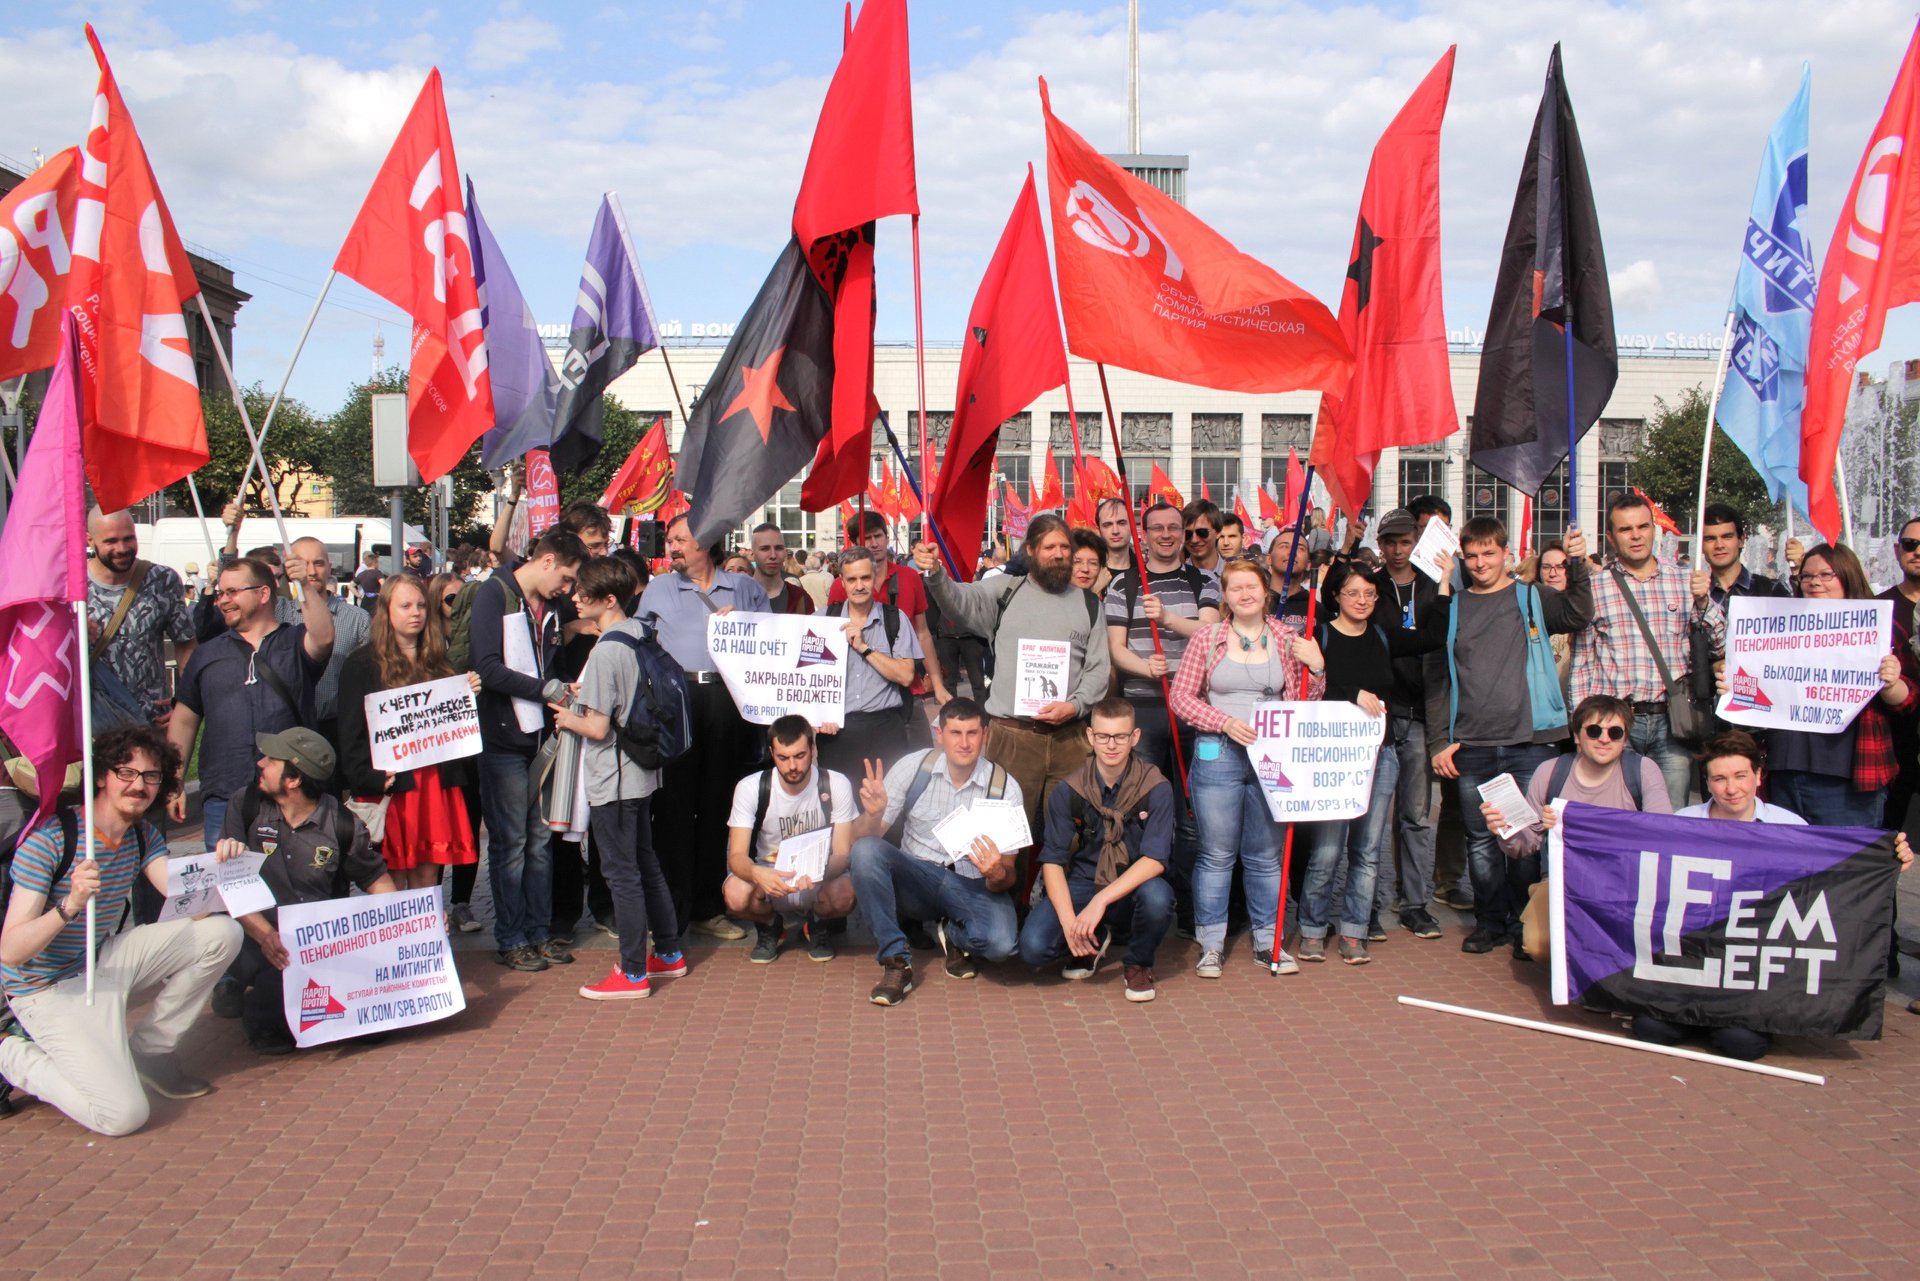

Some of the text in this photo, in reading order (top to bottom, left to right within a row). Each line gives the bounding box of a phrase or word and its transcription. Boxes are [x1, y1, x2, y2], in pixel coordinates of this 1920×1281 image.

[1153, 303, 1207, 329] ПАРТИЯ
[713, 621, 758, 637] ХВАТИТ
[1736, 608, 1877, 635] ПРОТИВ ПОВЫШЕНИЯ
[713, 638, 788, 656] ЗА НАШ СЧЁТ
[801, 643, 825, 654] ПРОТИВ
[802, 635, 825, 649] НАРОД
[1734, 630, 1878, 652] ПЕНСИОННОГО ВОЗРАСТА?
[1025, 661, 1059, 669] СРАЖАЙСЯ
[744, 671, 842, 688] ЗАКРЫВАТЬ ДЫРЫ
[1733, 674, 1758, 688] НАРОД
[1763, 664, 1882, 687] ВЫХОДИ НА МИТИНГ
[776, 688, 842, 704] В БЮДЖЕТЕ!
[1733, 683, 1758, 696] ПРОТИВ
[1805, 686, 1817, 699] 16
[379, 702, 387, 714] К
[400, 695, 473, 724] ПОЛИТИЧЕСКОЕ
[1254, 709, 1381, 738] НЕТ ПОВЫШЕНИЮ
[392, 722, 481, 761] СОПРОТИВЛЕНИЕ
[1259, 761, 1281, 772] НАРОД
[296, 894, 435, 947] ПРОТИВ ПОВЫШЕНИЯ
[300, 914, 437, 965] ПЕНСИОННОГО ВОЗРАСТА?
[398, 940, 444, 961] ВЫХОДИ
[375, 957, 445, 983] НА МИТИНГИ!
[302, 985, 330, 1000] НАРОД
[347, 987, 374, 1001] ВСТУПАЙ
[374, 987, 379, 996] В
[379, 981, 411, 996] РАЙОННЫЕ
[302, 995, 329, 1008] ПРОТИВ
[357, 991, 453, 1026] VK.COM/SPB.PROTIV
